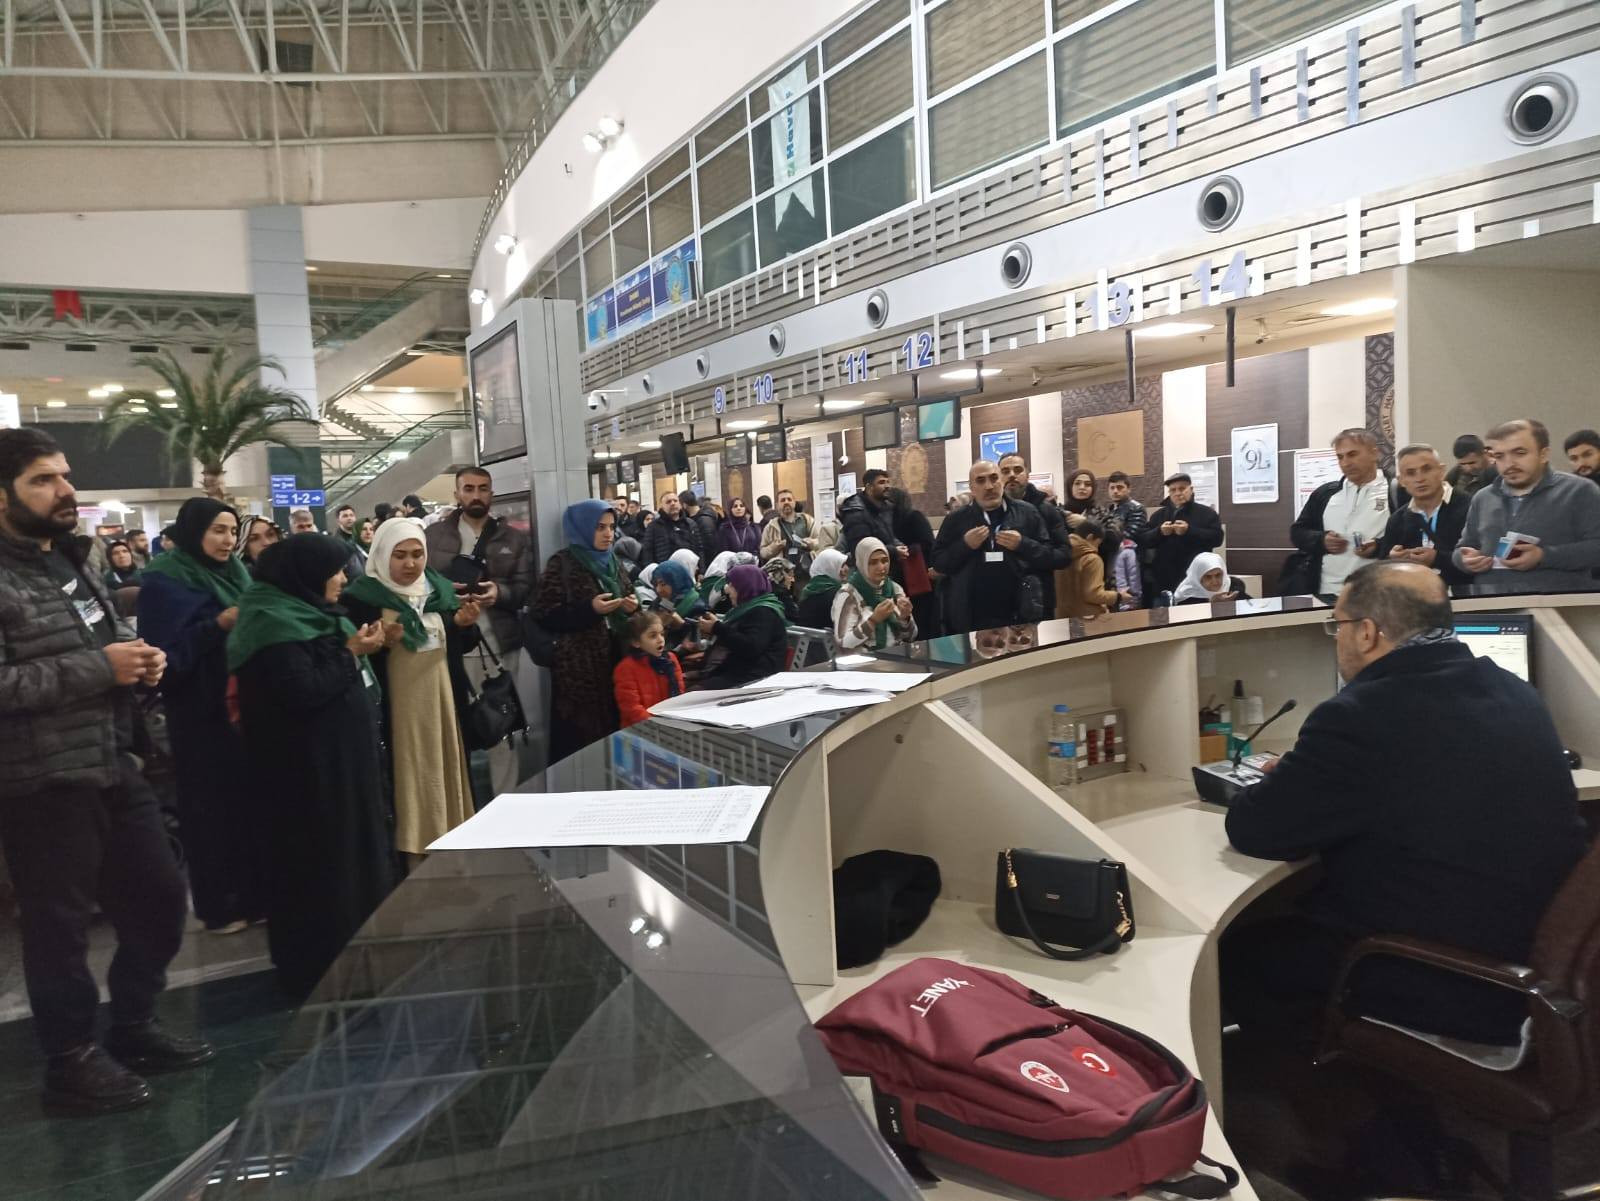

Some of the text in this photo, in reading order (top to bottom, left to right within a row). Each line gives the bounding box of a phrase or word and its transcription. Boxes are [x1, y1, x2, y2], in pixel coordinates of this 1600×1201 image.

[1191, 250, 1250, 305] 14
[1082, 281, 1132, 330] 13
[845, 348, 868, 383] 11
[902, 332, 933, 370] 12
[713, 387, 725, 414] 9
[754, 373, 774, 404] 10
[291, 493, 311, 504] 1-2
